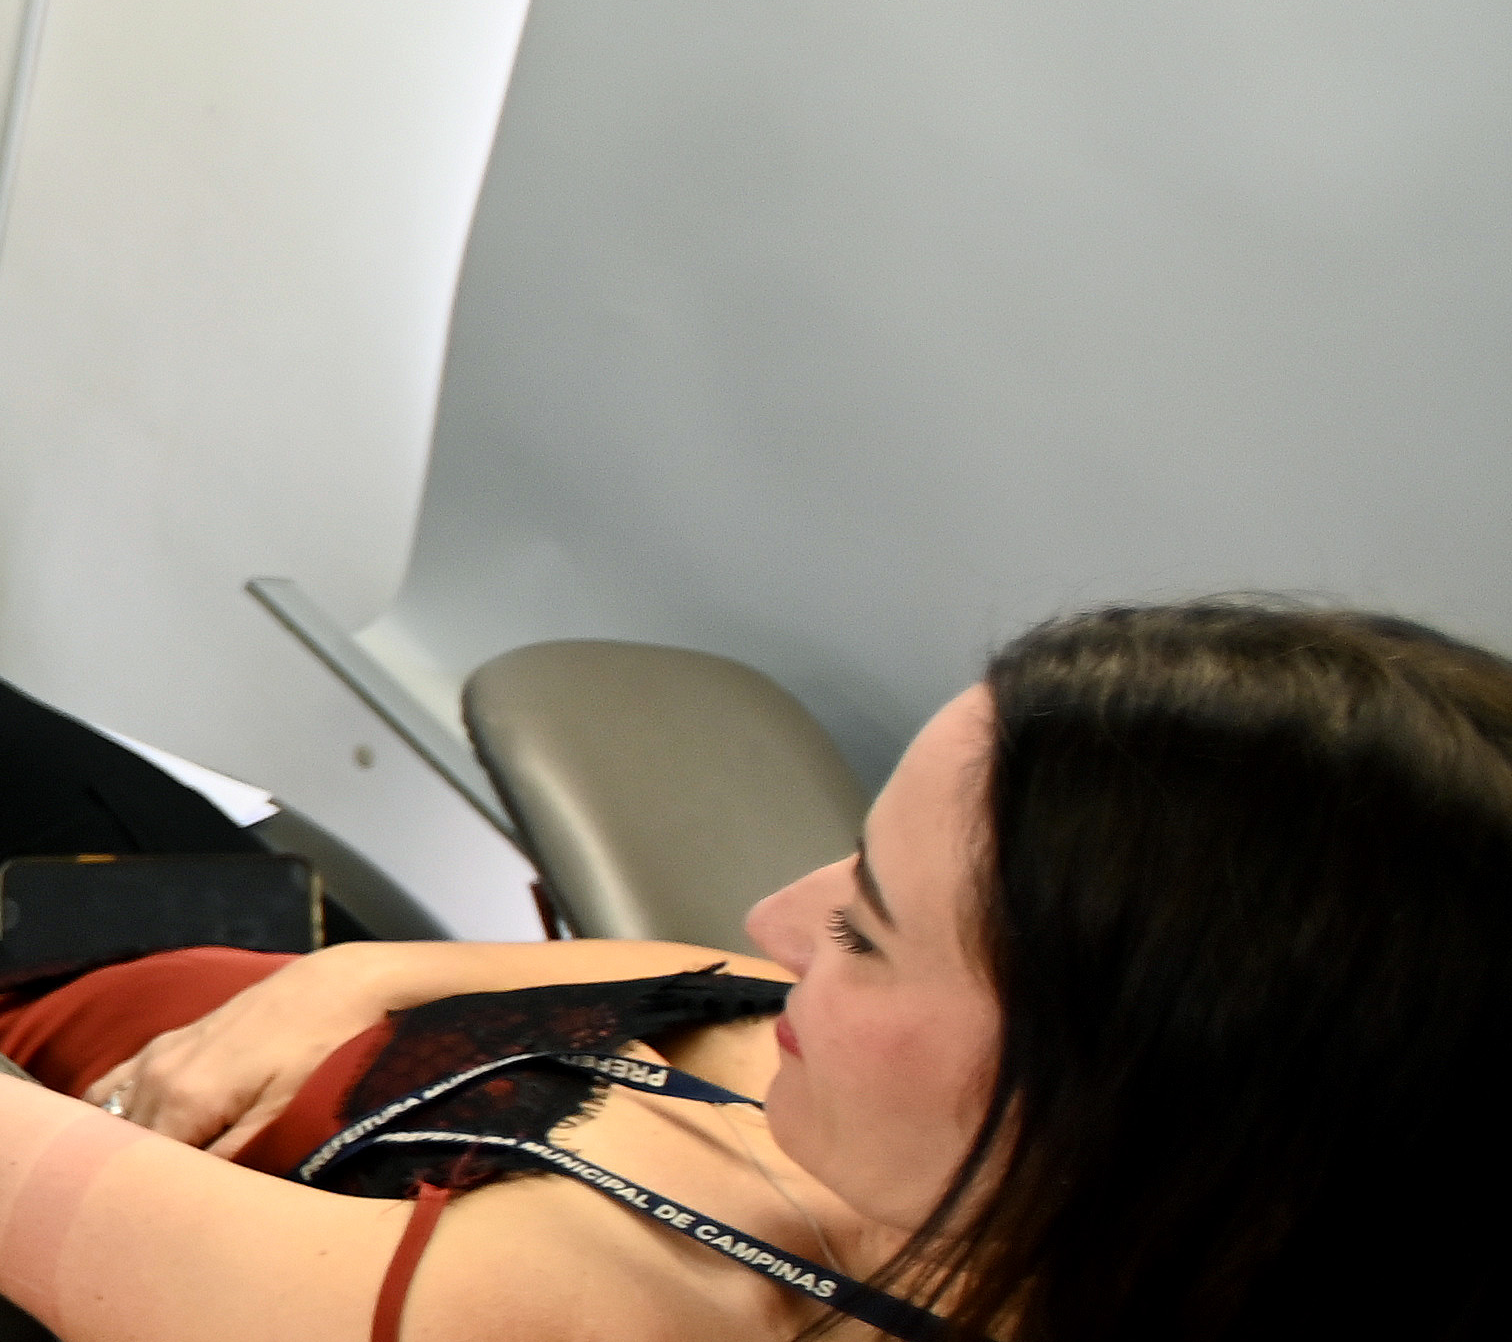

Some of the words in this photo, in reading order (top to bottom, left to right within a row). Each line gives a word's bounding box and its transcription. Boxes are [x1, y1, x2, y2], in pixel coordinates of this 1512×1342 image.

[518, 1141, 650, 1210] MUNICIPAL
[653, 1203, 698, 1230] DE
[693, 1224, 839, 1299] CAMPINAS
